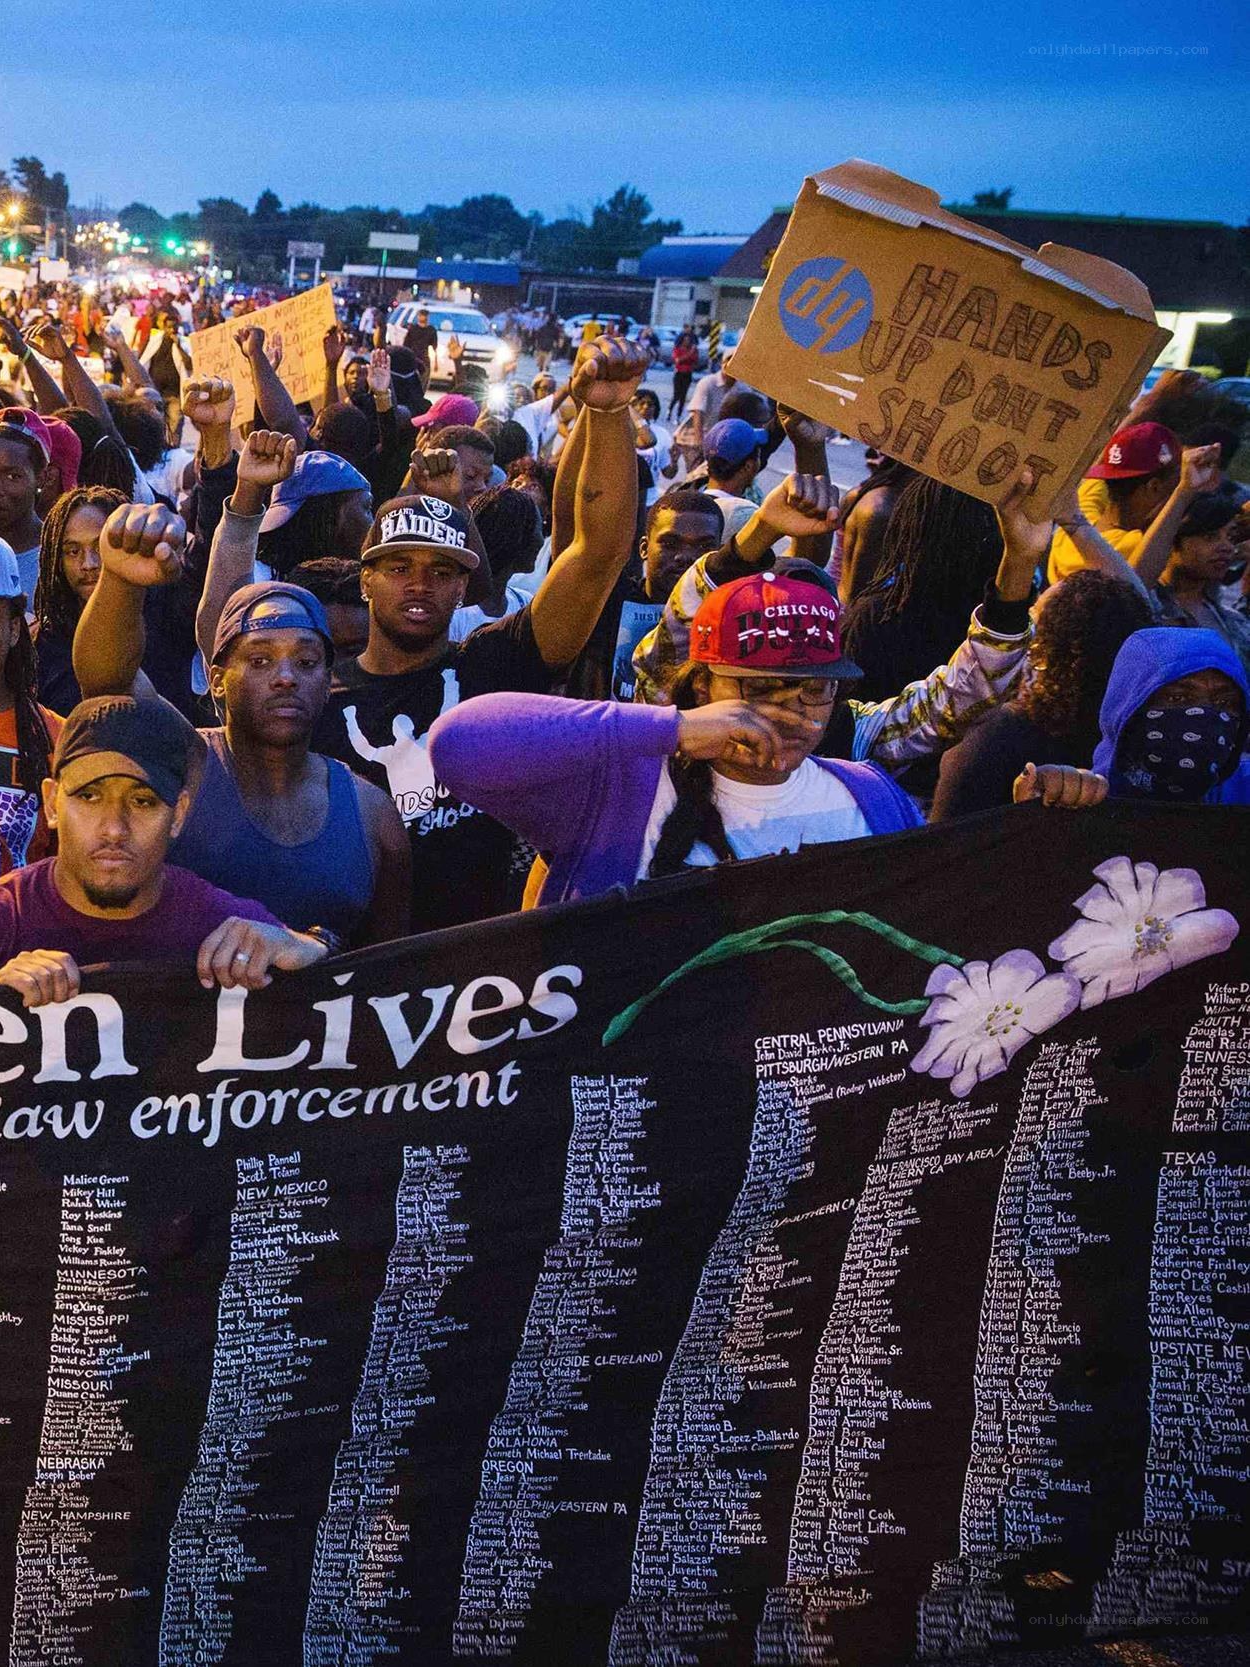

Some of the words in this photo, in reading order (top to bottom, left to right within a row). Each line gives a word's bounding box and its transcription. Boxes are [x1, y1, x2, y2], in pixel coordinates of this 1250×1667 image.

[891, 262, 1112, 391] HANDS
[859, 319, 935, 384] UP
[937, 360, 1081, 442] DONT
[857, 387, 1058, 497] SHOOT
[381, 514, 466, 548] RAIDERS
[765, 605, 835, 620] CHICAGO
[196, 963, 583, 1073] Lives
[755, 1033, 815, 1050] CENTRAL
[818, 1019, 904, 1043] PENNSYLVANIA
[756, 1044, 884, 1078] PITTSBURGH/WESTERN
[891, 1039, 909, 1055] PA
[571, 1075, 604, 1089] Richard
[1022, 1079, 1055, 1093] Joannie
[1058, 1076, 1094, 1088] Holmes
[571, 1086, 609, 1100] Richard
[615, 1087, 639, 1099] Luke
[1020, 1092, 1041, 1103] John
[1045, 1088, 1071, 1099] Calvin
[1074, 1086, 1097, 1098] Dine
[129, 1057, 522, 1149] enforcement
[236, 1157, 264, 1172] Phillip
[268, 1151, 301, 1168] Pannell
[867, 1164, 888, 1176] SAN
[891, 1155, 941, 1172] FRANCISCO
[944, 1154, 964, 1166] BAY
[965, 1145, 1005, 1162] AREA/
[1162, 1151, 1217, 1165] TEXAS
[63, 1175, 97, 1186] Malice
[99, 1175, 129, 1185] Green
[866, 1168, 925, 1186] NORTHERN
[930, 1165, 944, 1175] CA
[236, 1186, 269, 1202] NEW
[274, 1179, 328, 1197] MEXICO
[997, 1194, 1023, 1205] Kevin
[1026, 1190, 1073, 1203] Saunders
[1157, 1187, 1199, 1199] Ernest
[1204, 1188, 1241, 1199] Moore
[397, 1203, 420, 1214] Frank
[423, 1201, 447, 1213] Olsen
[1152, 1245, 1188, 1259] Megan
[1192, 1245, 1226, 1256] Jones
[56, 1266, 148, 1280] MINNESOTA
[538, 1272, 576, 1283] NORTH
[582, 1267, 638, 1279] CAROLINA
[1150, 1268, 1179, 1279] Pedro
[1148, 1291, 1175, 1305] Tony
[1177, 1292, 1212, 1306] Reyes
[217, 1309, 247, 1320] Larry
[253, 1307, 289, 1320] Harper
[1148, 1302, 1181, 1314] Travis
[1183, 1304, 1213, 1316] Allen
[52, 1314, 130, 1326] MISSISSIPPI
[1150, 1341, 1214, 1358] UPSTATE
[48, 1377, 113, 1391] MISSOURI
[488, 1437, 558, 1448] OKLAHOMA
[36, 1457, 106, 1470] NEBRASKA
[481, 1461, 534, 1474] OREGON
